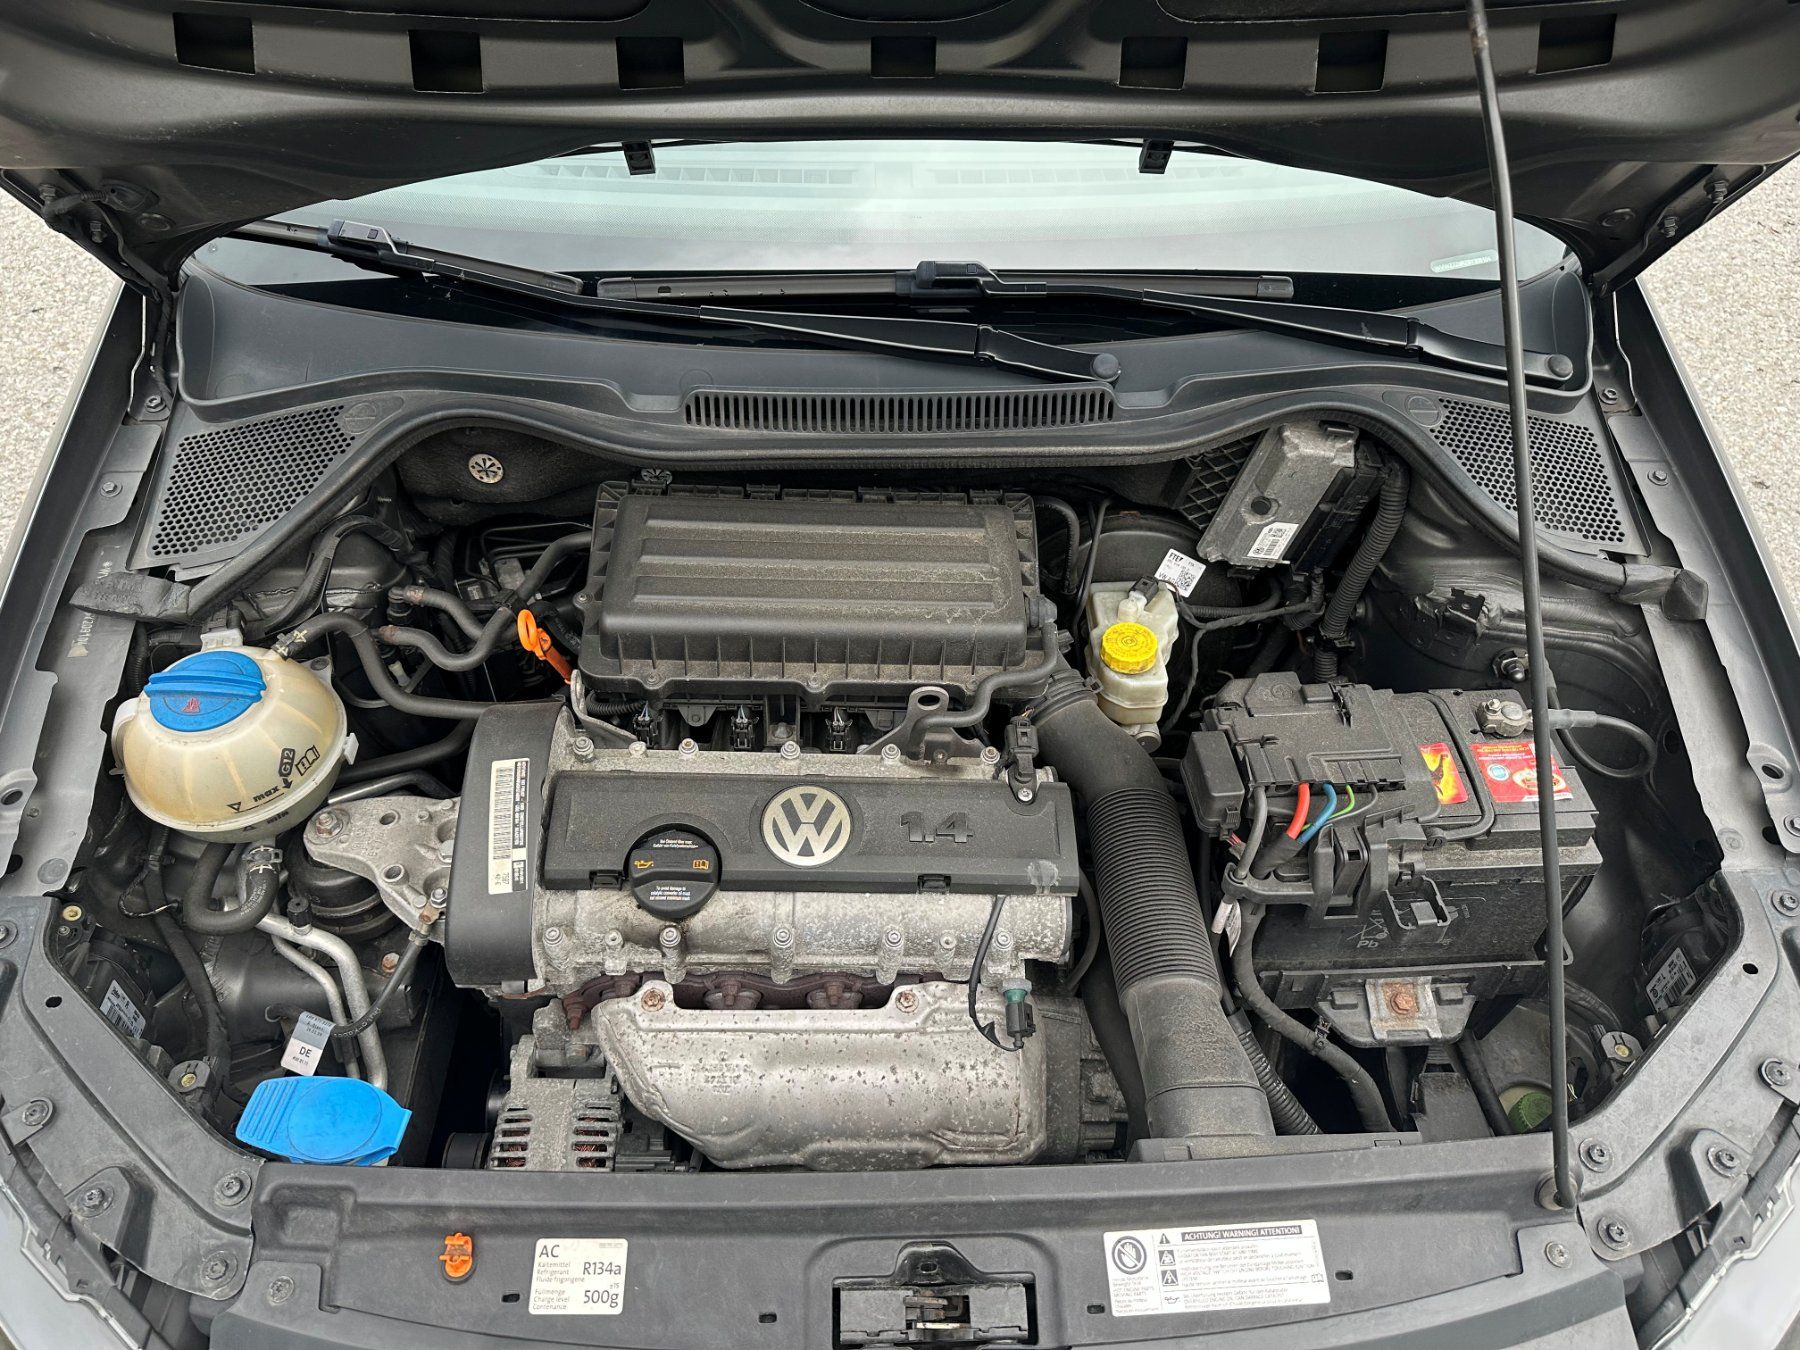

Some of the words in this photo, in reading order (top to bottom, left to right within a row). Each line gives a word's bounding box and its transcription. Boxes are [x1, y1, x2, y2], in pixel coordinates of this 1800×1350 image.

[282, 750, 294, 773] G12
[253, 786, 281, 802] max
[763, 785, 851, 866] VW
[900, 811, 974, 843] 1.4
[1356, 940, 1379, 948] Pb
[299, 1046, 311, 1058] DE
[1184, 1231, 1220, 1240] ACHTUNG!
[1222, 1228, 1259, 1238] WARNING!
[1260, 1226, 1301, 1236] ATTENTION!
[539, 1244, 560, 1258] AC
[583, 1262, 621, 1275] R134a
[583, 1290, 619, 1308] 500g
